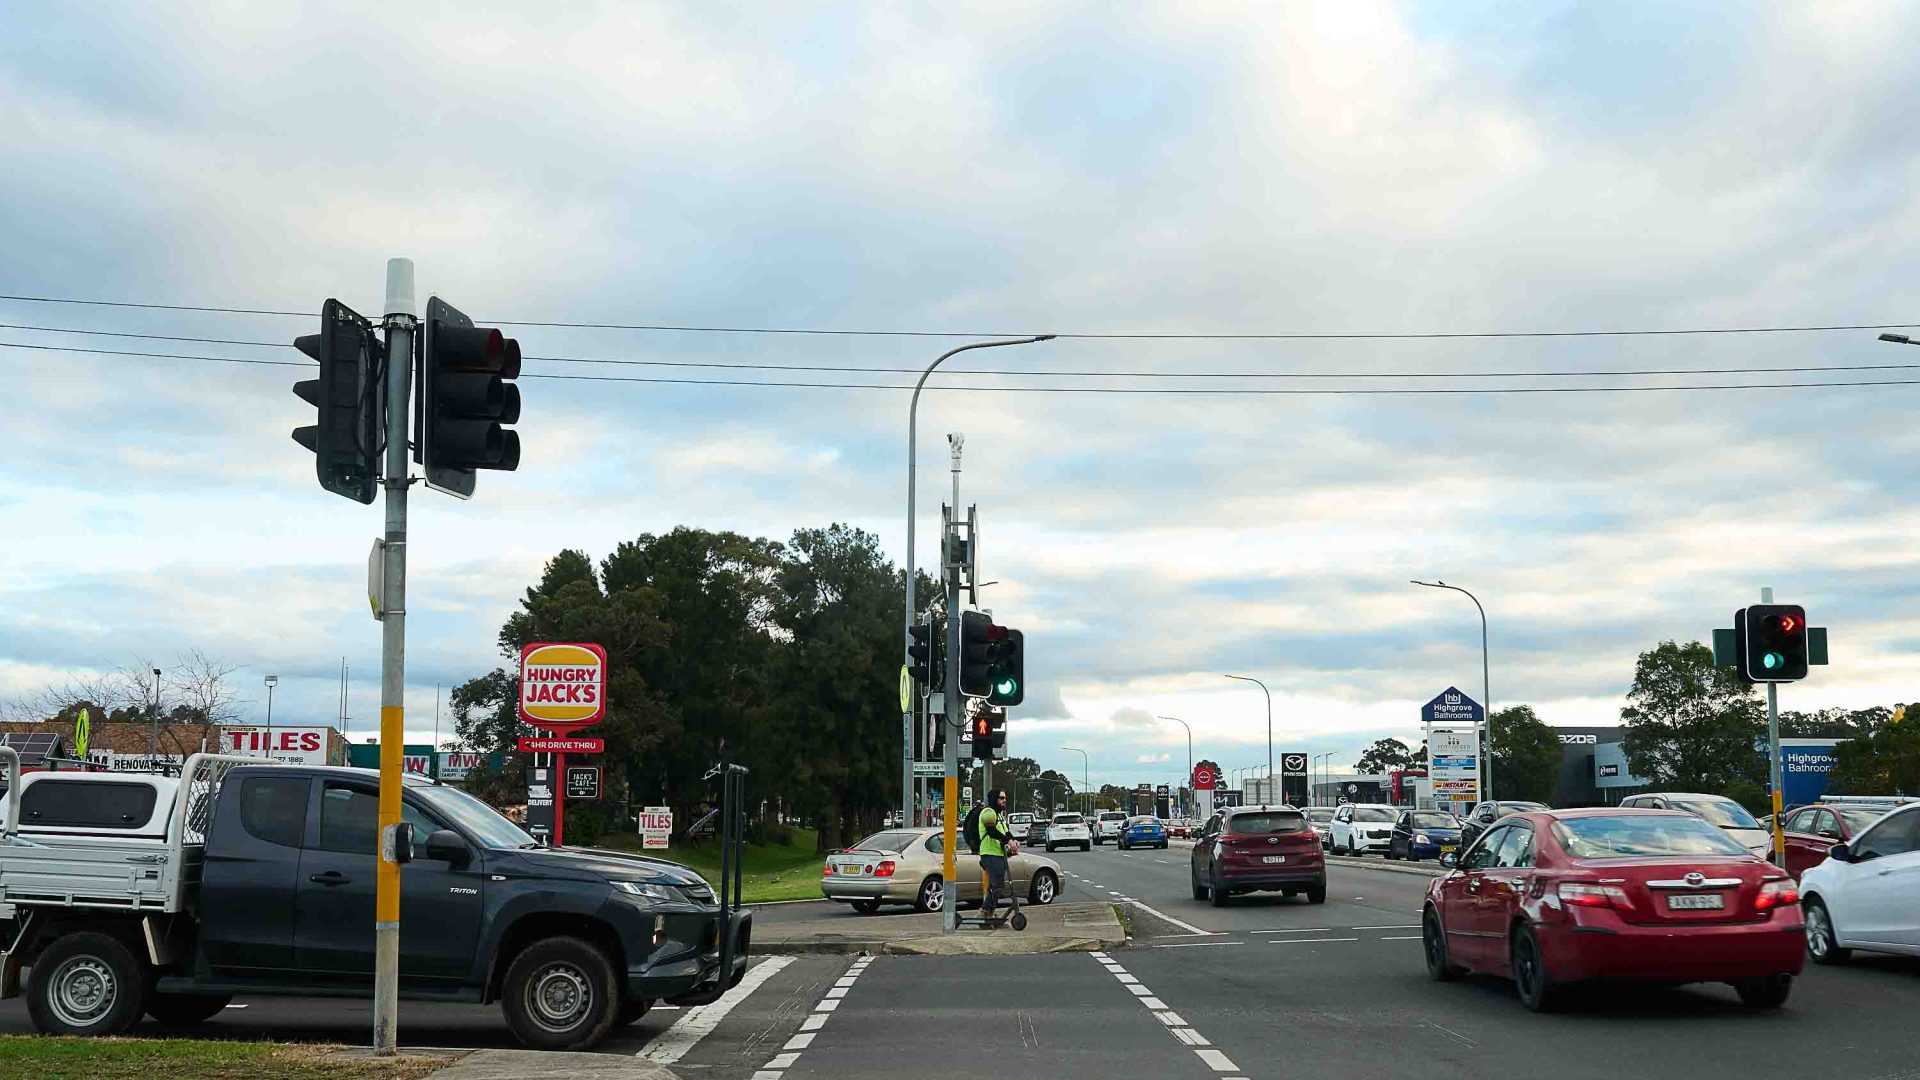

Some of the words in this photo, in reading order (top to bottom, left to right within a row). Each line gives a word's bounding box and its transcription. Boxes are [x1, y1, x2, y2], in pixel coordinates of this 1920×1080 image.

[527, 668, 597, 682] HUNGRY
[526, 684, 597, 703] JACK'S
[1433, 704, 1473, 712] Highgrove
[1434, 711, 1473, 719] Bathrooms
[227, 731, 321, 751] TILES
[1557, 734, 1597, 744] azda
[547, 741, 573, 749] DRIVE
[573, 741, 596, 749] THRU
[114, 759, 176, 770] RENOVATIO
[402, 757, 426, 773] W
[448, 754, 478, 767] MW
[1788, 763, 1833, 772] Bathroo
[527, 799, 553, 807] DELIVERY
[640, 814, 672, 829] TILES
[449, 887, 478, 895] TRITON
